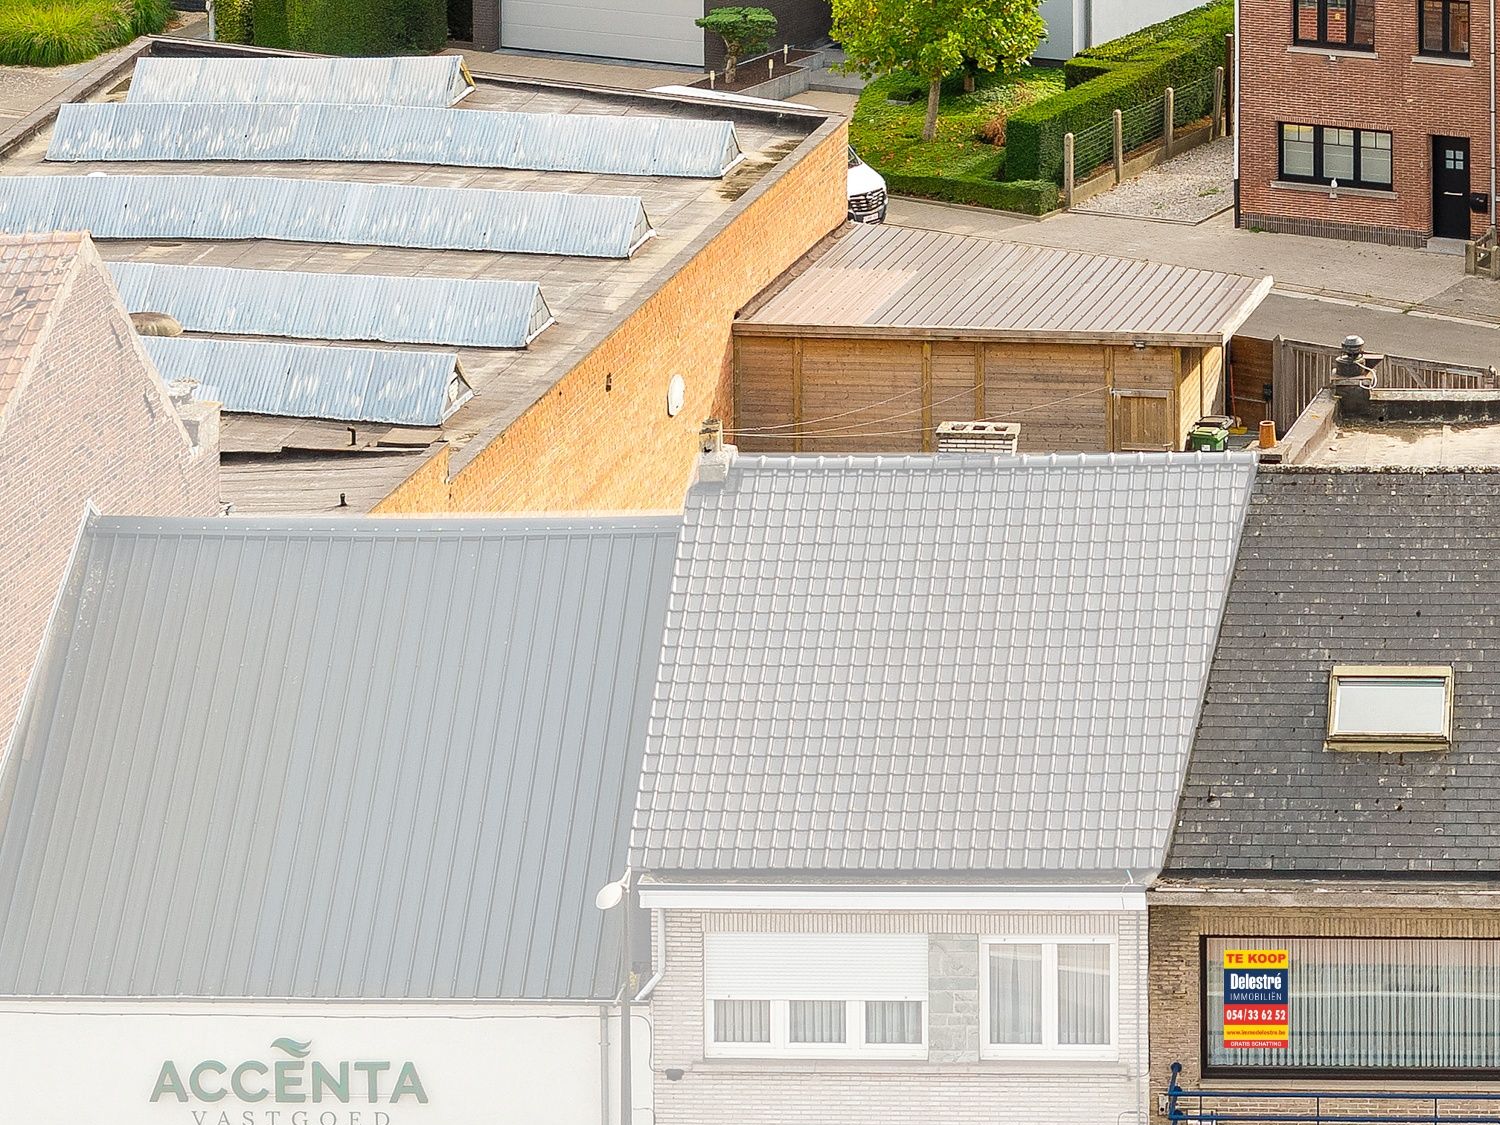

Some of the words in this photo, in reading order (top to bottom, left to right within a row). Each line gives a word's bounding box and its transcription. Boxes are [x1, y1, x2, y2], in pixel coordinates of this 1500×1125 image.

[1226, 953, 1243, 963] TE
[1248, 953, 1286, 963] KOOP
[1230, 973, 1282, 990] Delestré
[1230, 992, 1282, 1001] IMMOBILIËN
[1226, 1008, 1259, 1021] 054/33
[1261, 1009, 1272, 1020] 62
[1275, 1009, 1286, 1020] 52
[149, 1060, 429, 1104] ACCENTA
